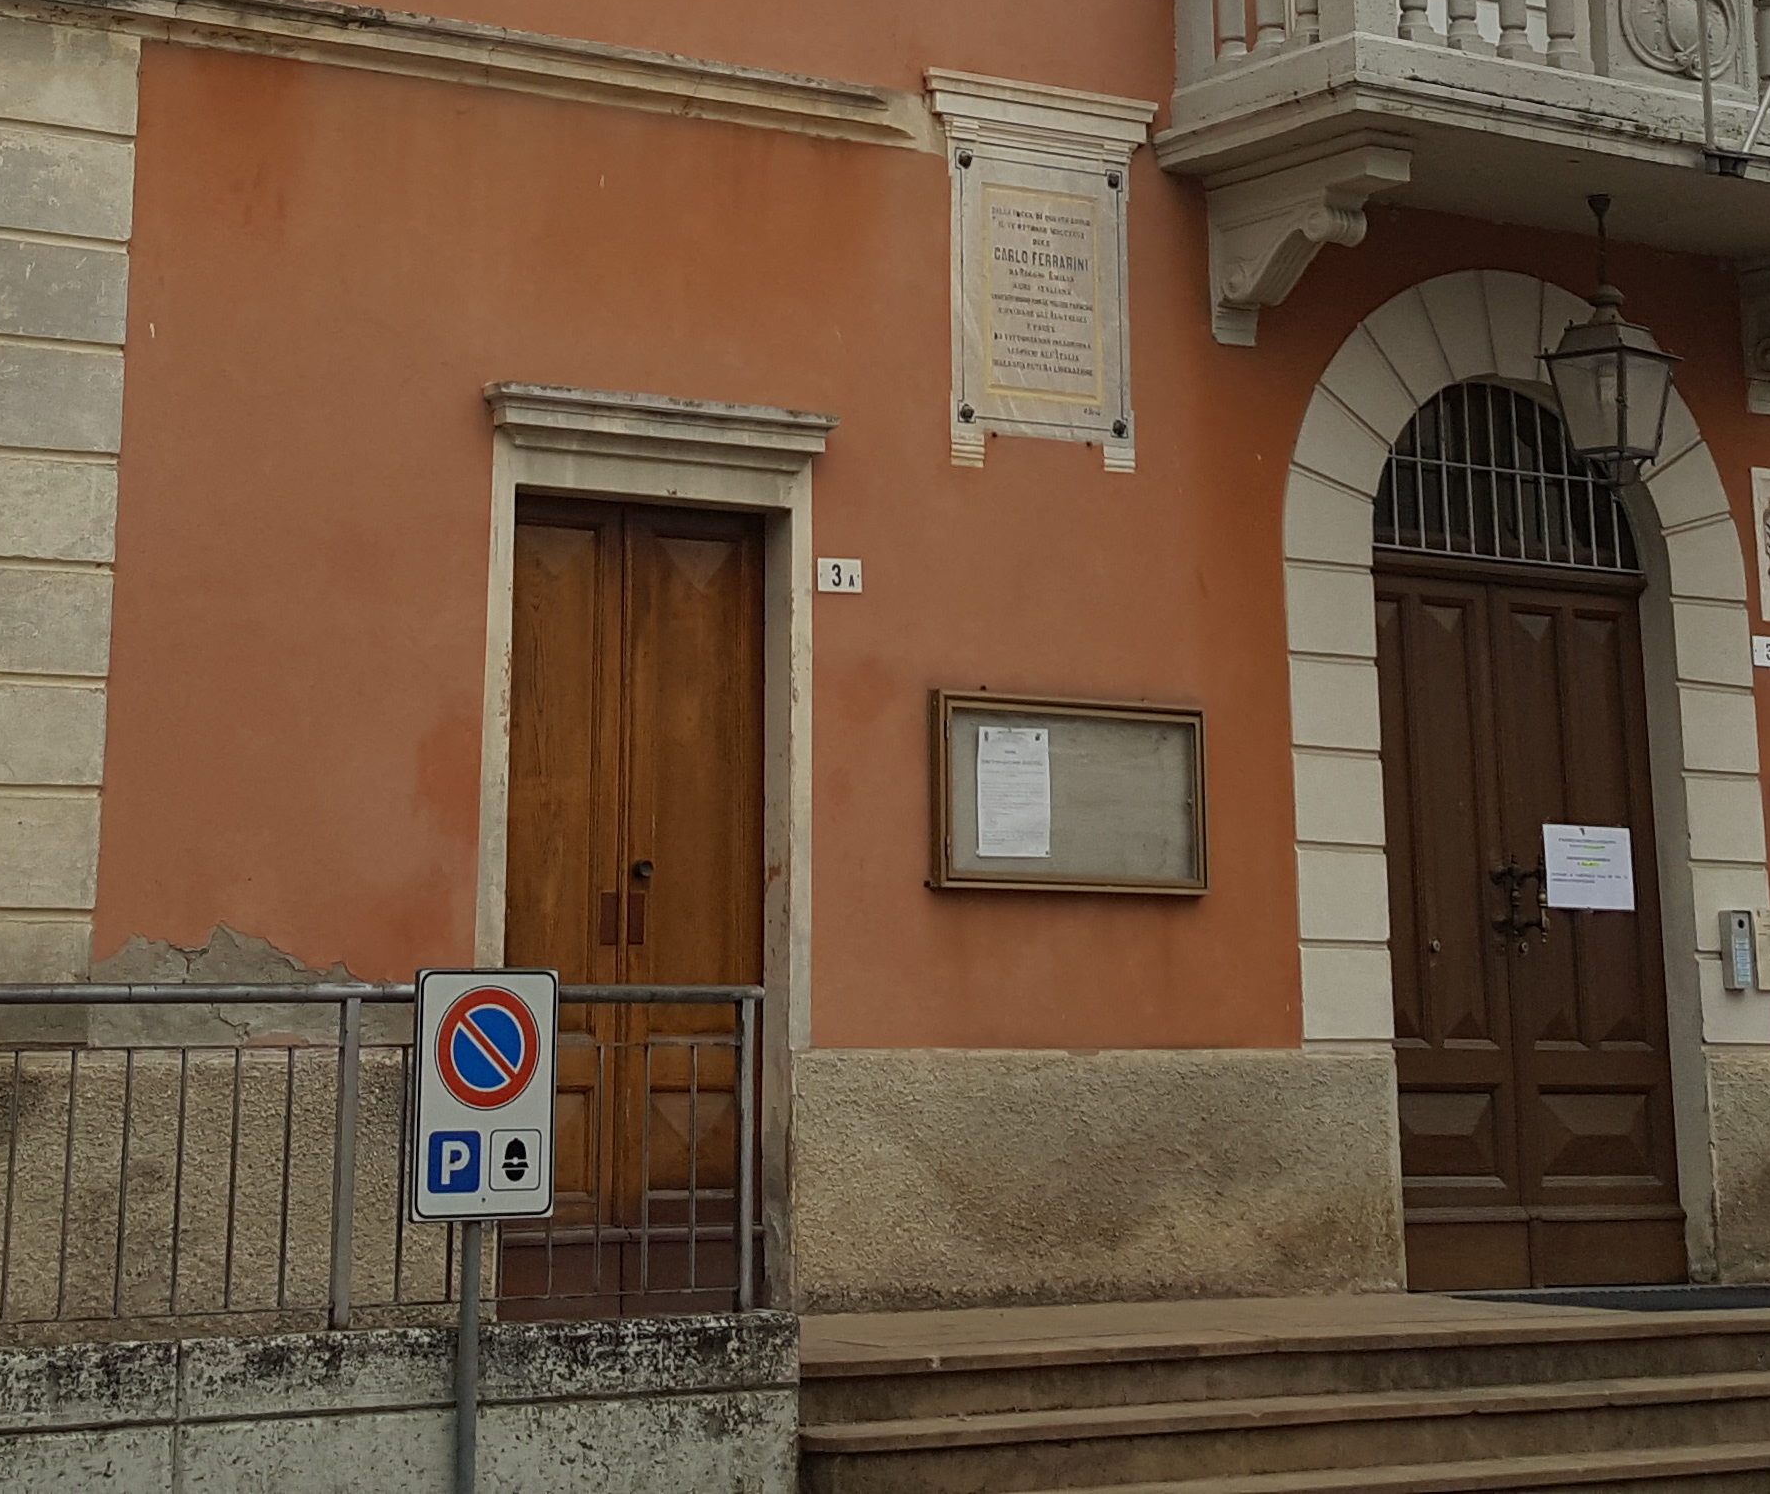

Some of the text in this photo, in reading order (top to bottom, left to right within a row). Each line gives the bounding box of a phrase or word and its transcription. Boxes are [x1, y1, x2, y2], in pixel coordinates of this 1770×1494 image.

[993, 246, 1089, 272] CARLO FERRARINI
[441, 1140, 471, 1185] P
